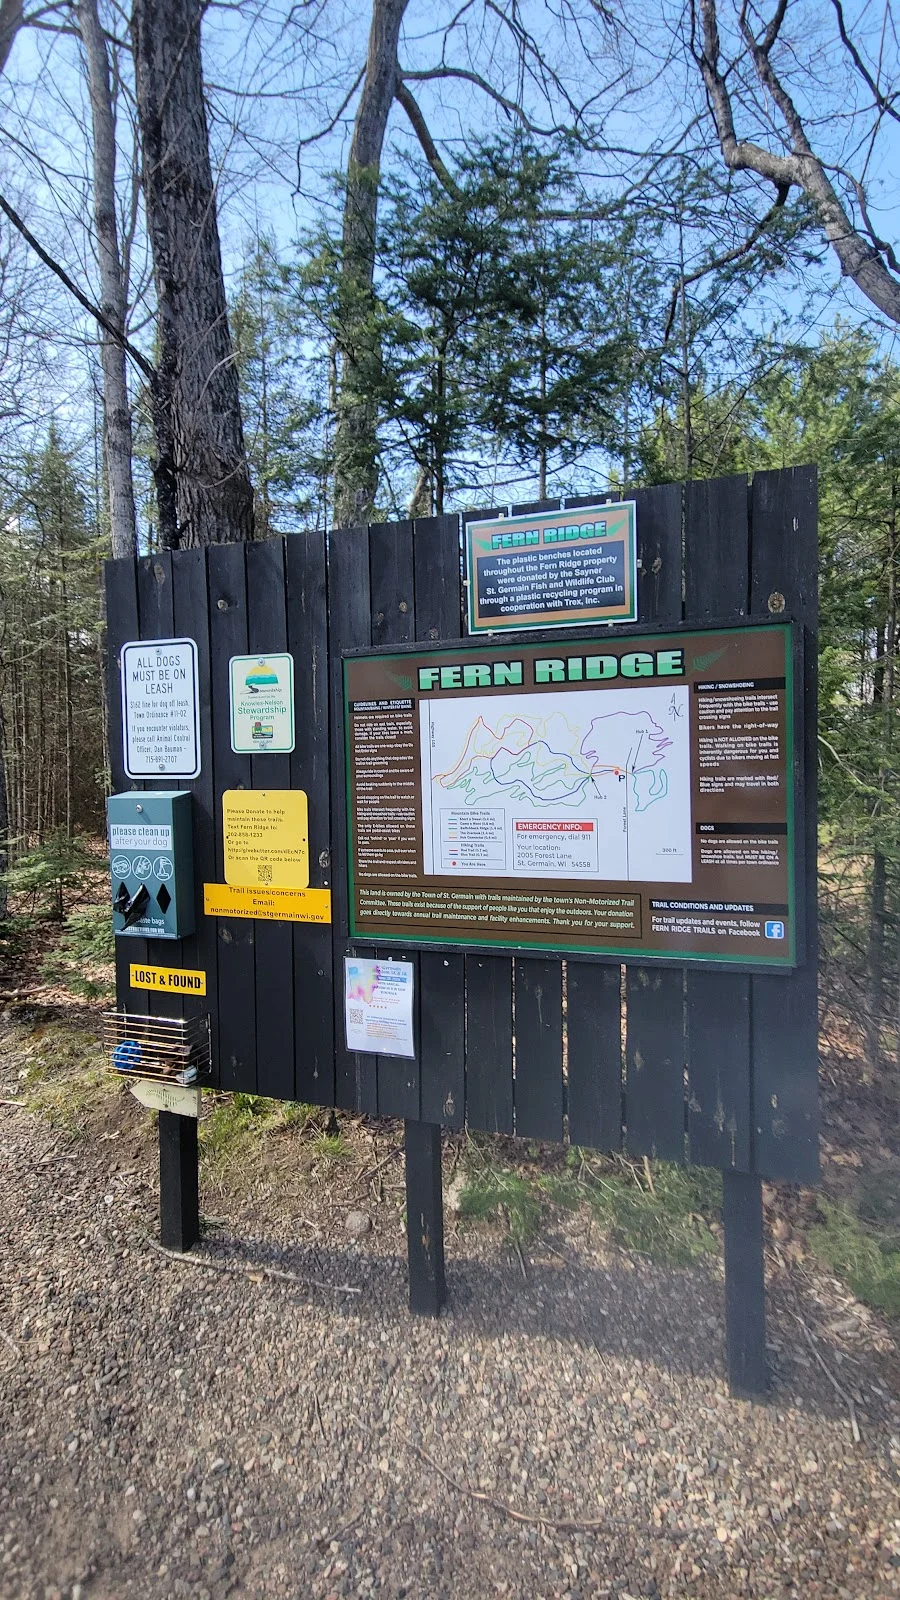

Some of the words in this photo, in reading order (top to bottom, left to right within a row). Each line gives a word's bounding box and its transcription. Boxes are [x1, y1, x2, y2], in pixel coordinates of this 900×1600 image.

[492, 530, 539, 549] FERN
[544, 521, 607, 544] RIDGE
[497, 557, 510, 565] The
[512, 555, 537, 565] plastic
[539, 551, 571, 561] benches
[573, 547, 602, 557] located
[484, 565, 524, 576] throughout
[559, 559, 581, 568] Ridge
[584, 556, 617, 567] property
[517, 572, 547, 582] donated
[549, 571, 559, 580] by
[575, 568, 602, 577] Sayner
[499, 584, 529, 593] Germain
[531, 582, 547, 590] Fish
[549, 580, 563, 588] and
[566, 577, 594, 587] Wildlife
[596, 575, 615, 584] Club
[480, 595, 508, 604] through
[516, 592, 541, 603] plastic
[543, 589, 578, 599] recycling
[580, 586, 613, 596] program
[501, 602, 544, 612] cooperation
[547, 599, 562, 608] with
[137, 657, 152, 668] ALL
[157, 656, 180, 667] DOGS
[133, 671, 155, 681] MUST
[159, 670, 169, 680] BE
[174, 669, 186, 679] ON
[418, 661, 524, 692] FERN
[533, 648, 686, 685] RIDGE
[146, 683, 172, 694] LEASH
[238, 706, 286, 715] Stewardship
[112, 826, 136, 836] please
[138, 827, 158, 836] clean
[160, 828, 170, 837] up
[115, 837, 132, 845] after
[134, 838, 150, 846] your
[153, 838, 168, 848] dog
[247, 888, 306, 897] issues/concerns
[210, 907, 324, 920] nonmotorized@stgermainwi.gov
[729, 928, 760, 936] Facebook
[135, 971, 156, 984] LOST
[160, 975, 166, 985] &
[168, 974, 201, 988] FOUND
